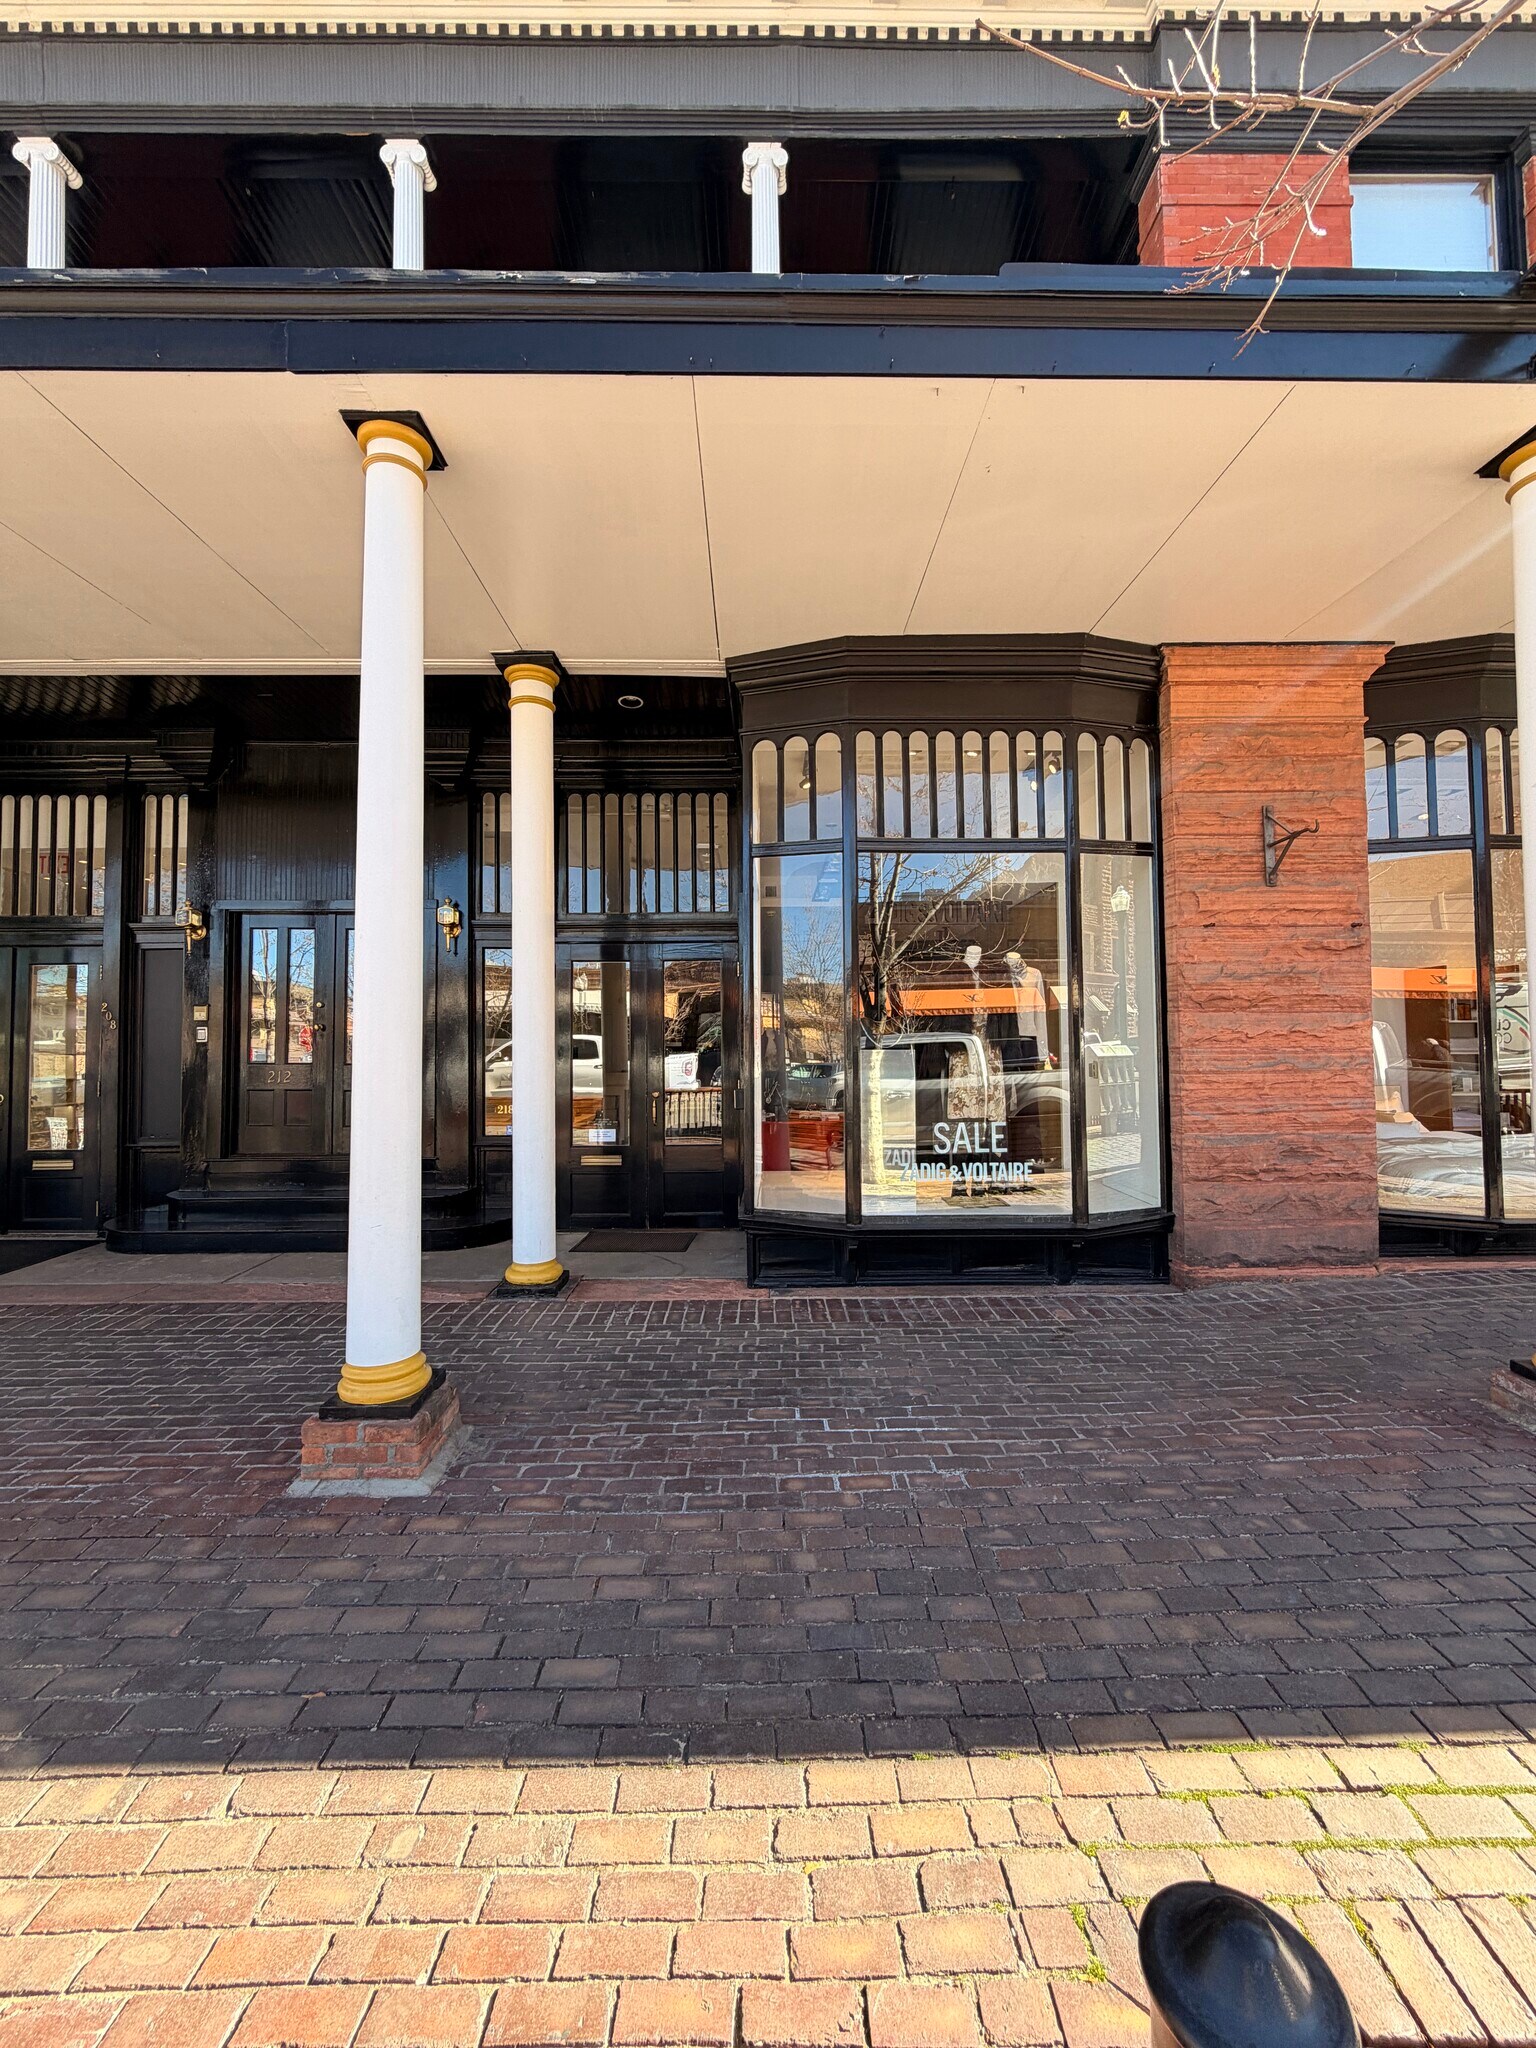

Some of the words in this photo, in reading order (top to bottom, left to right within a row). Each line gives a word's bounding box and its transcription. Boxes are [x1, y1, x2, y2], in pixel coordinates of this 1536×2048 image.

[101, 1002, 117, 1030] 208
[267, 1070, 292, 1084] 212
[933, 1121, 1008, 1154] SALE
